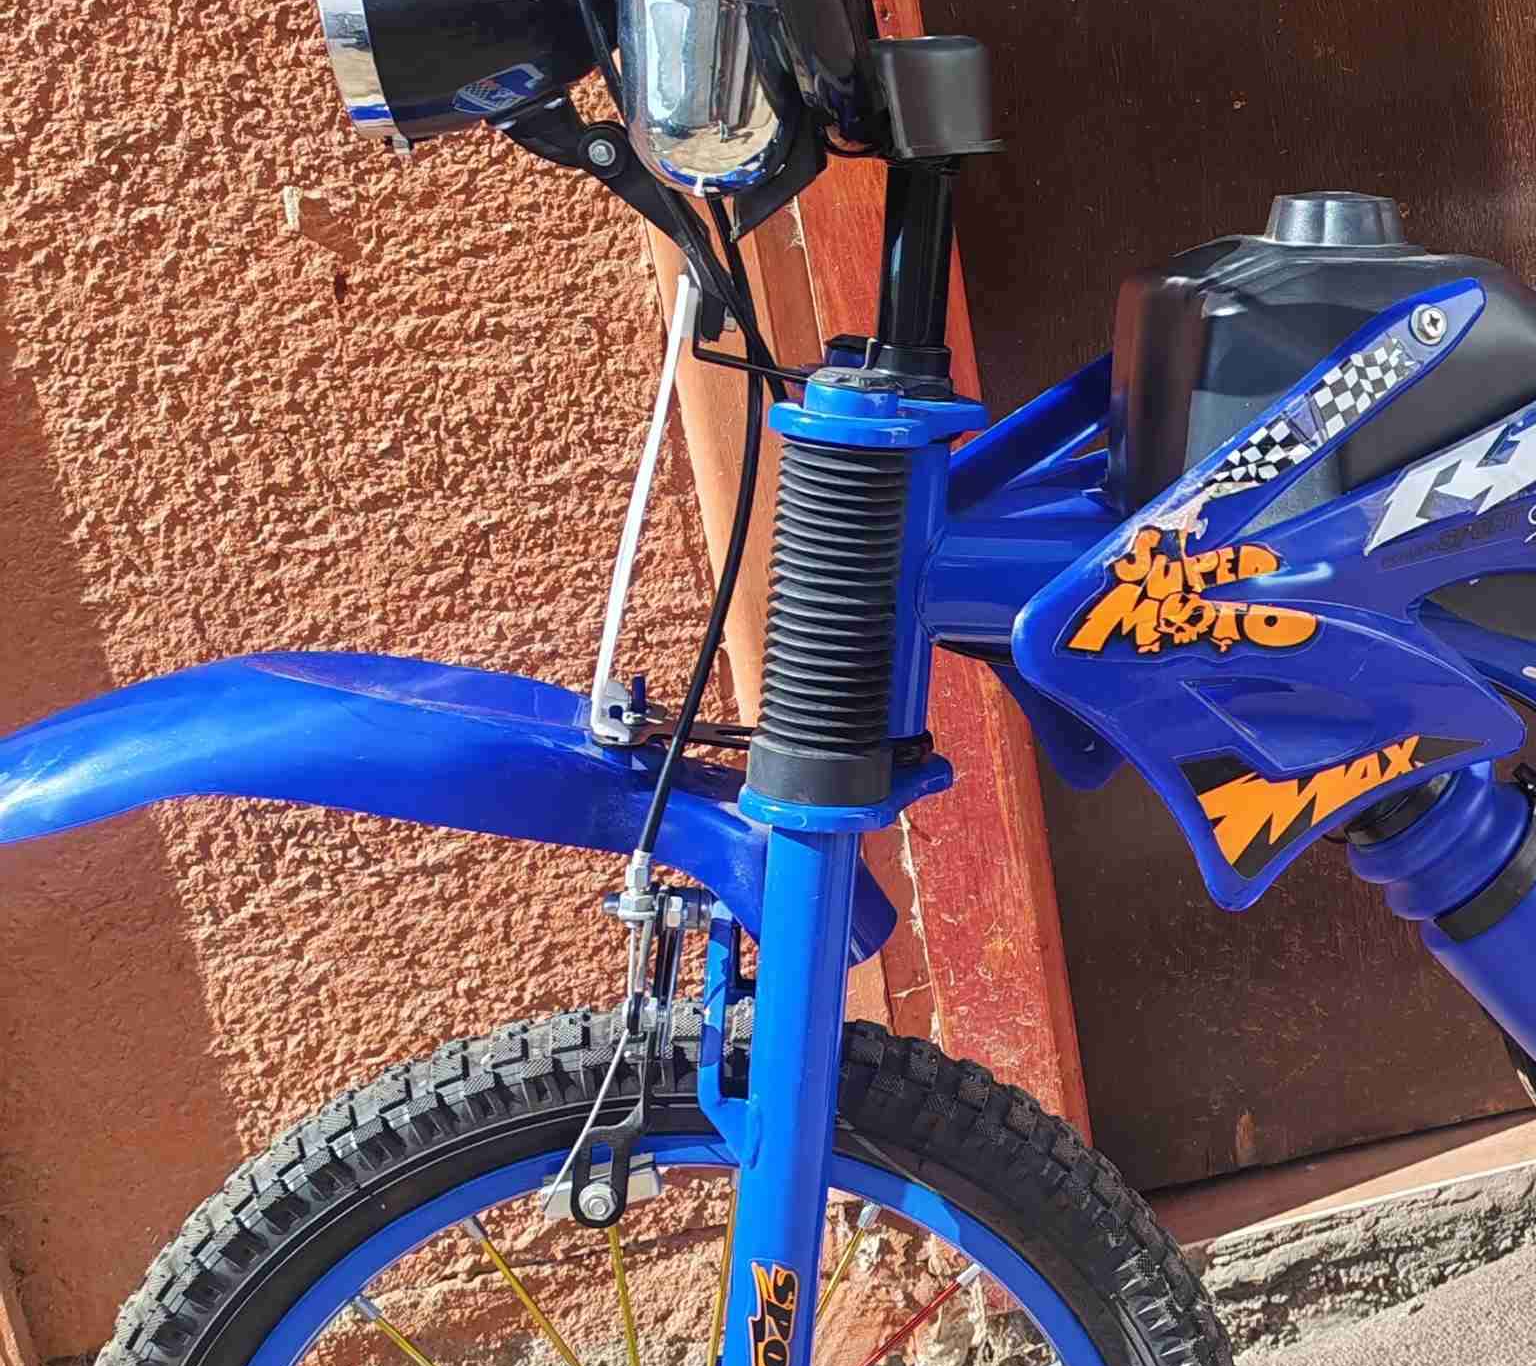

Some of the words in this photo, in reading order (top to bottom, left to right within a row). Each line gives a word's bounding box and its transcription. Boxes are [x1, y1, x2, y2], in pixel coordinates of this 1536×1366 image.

[1112, 526, 1281, 600] SUPER
[1066, 583, 1318, 654] MOTO
[1197, 734, 1421, 867] MAX
